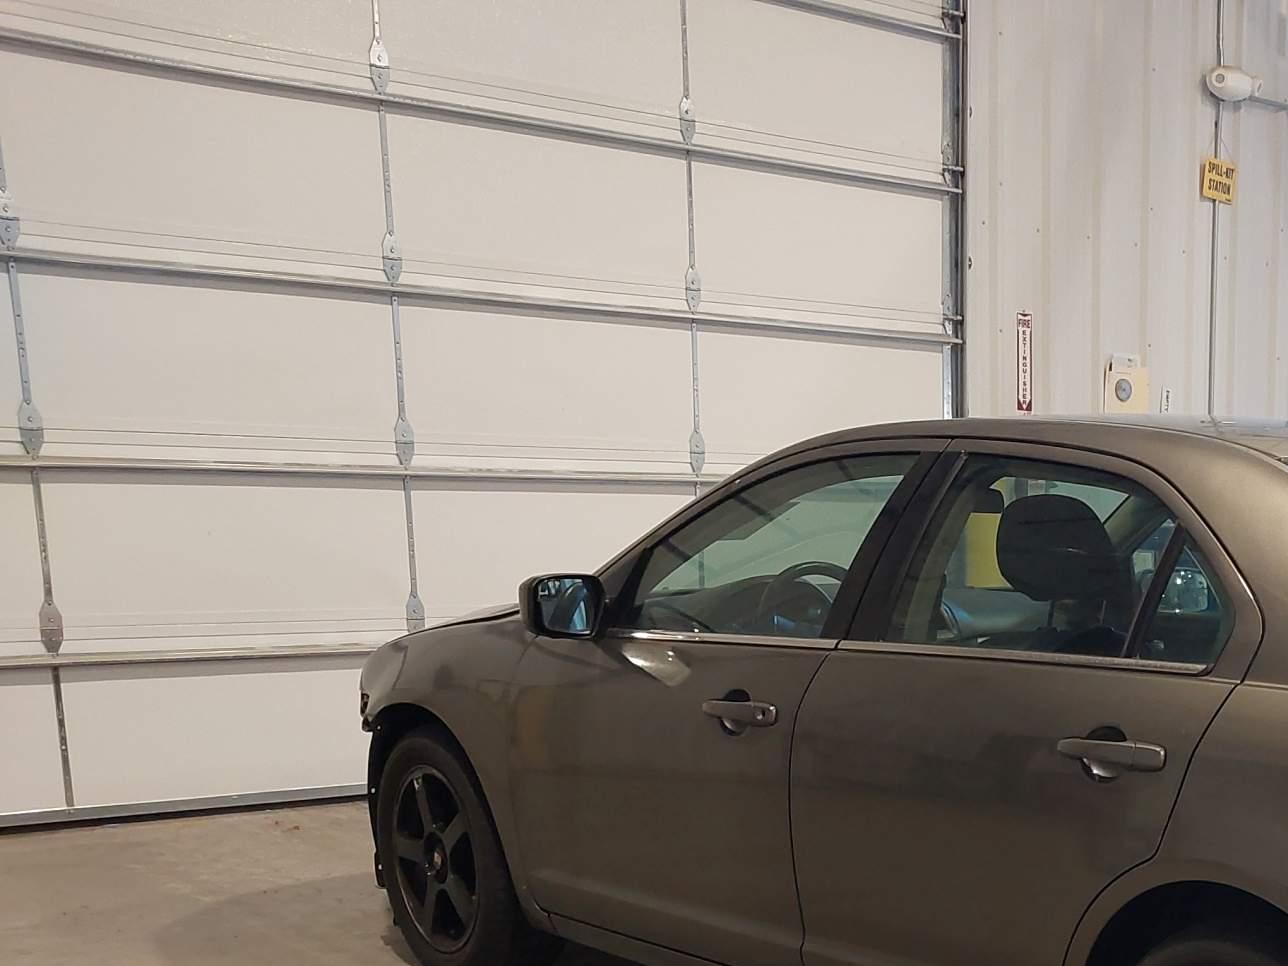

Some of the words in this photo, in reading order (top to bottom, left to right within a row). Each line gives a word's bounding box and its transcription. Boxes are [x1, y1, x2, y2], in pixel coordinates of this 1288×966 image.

[1208, 161, 1234, 180] SPILL-KIT
[1208, 178, 1231, 196] STATION
[1018, 318, 1031, 329] FIRE
